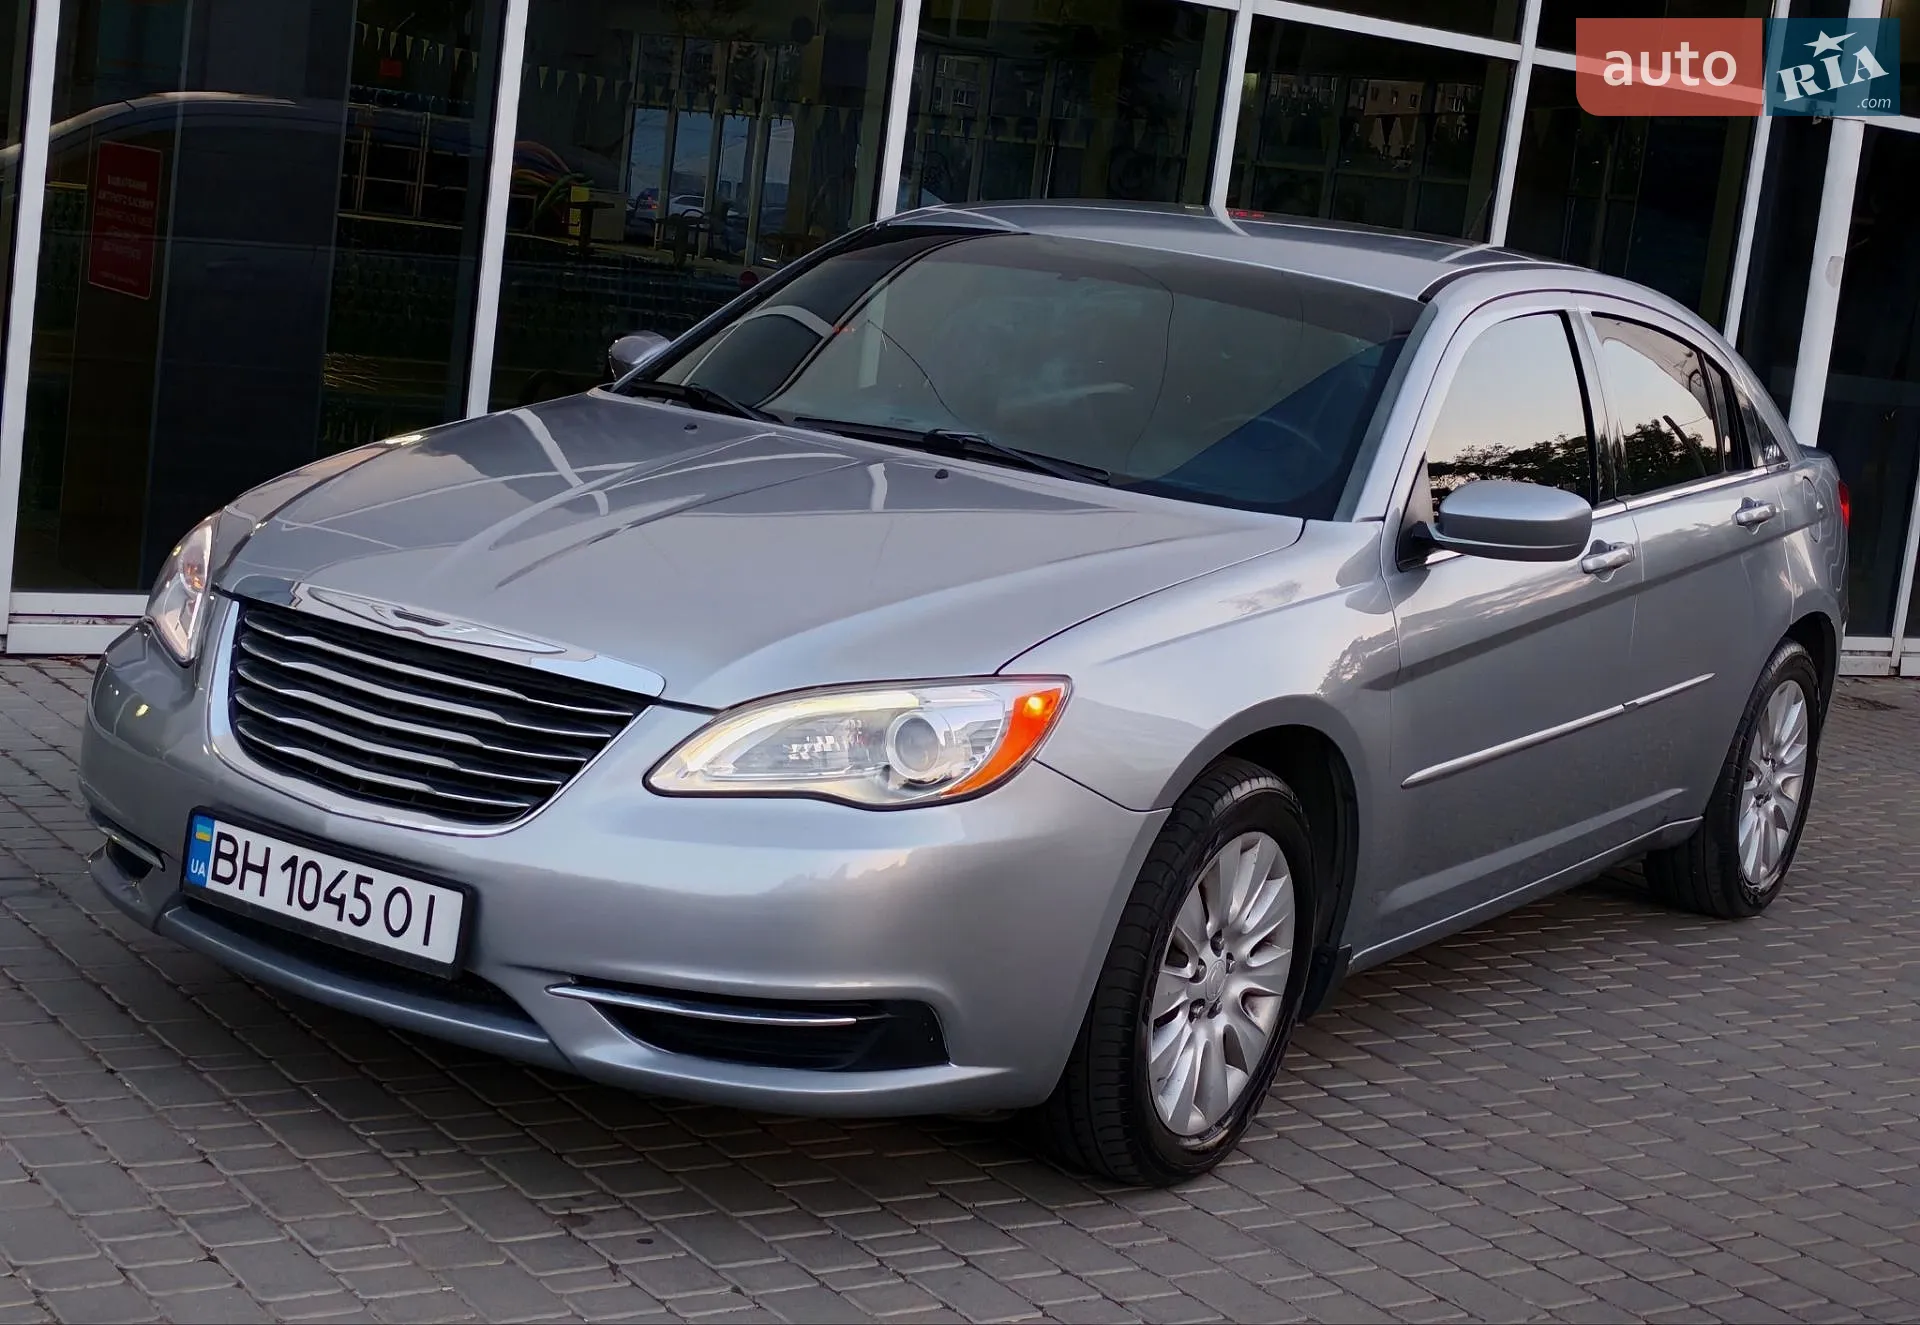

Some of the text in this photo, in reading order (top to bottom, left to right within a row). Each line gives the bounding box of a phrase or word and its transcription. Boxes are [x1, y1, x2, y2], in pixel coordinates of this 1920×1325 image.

[191, 858, 206, 878] UA
[211, 831, 271, 897] BH
[280, 855, 374, 927] 1045
